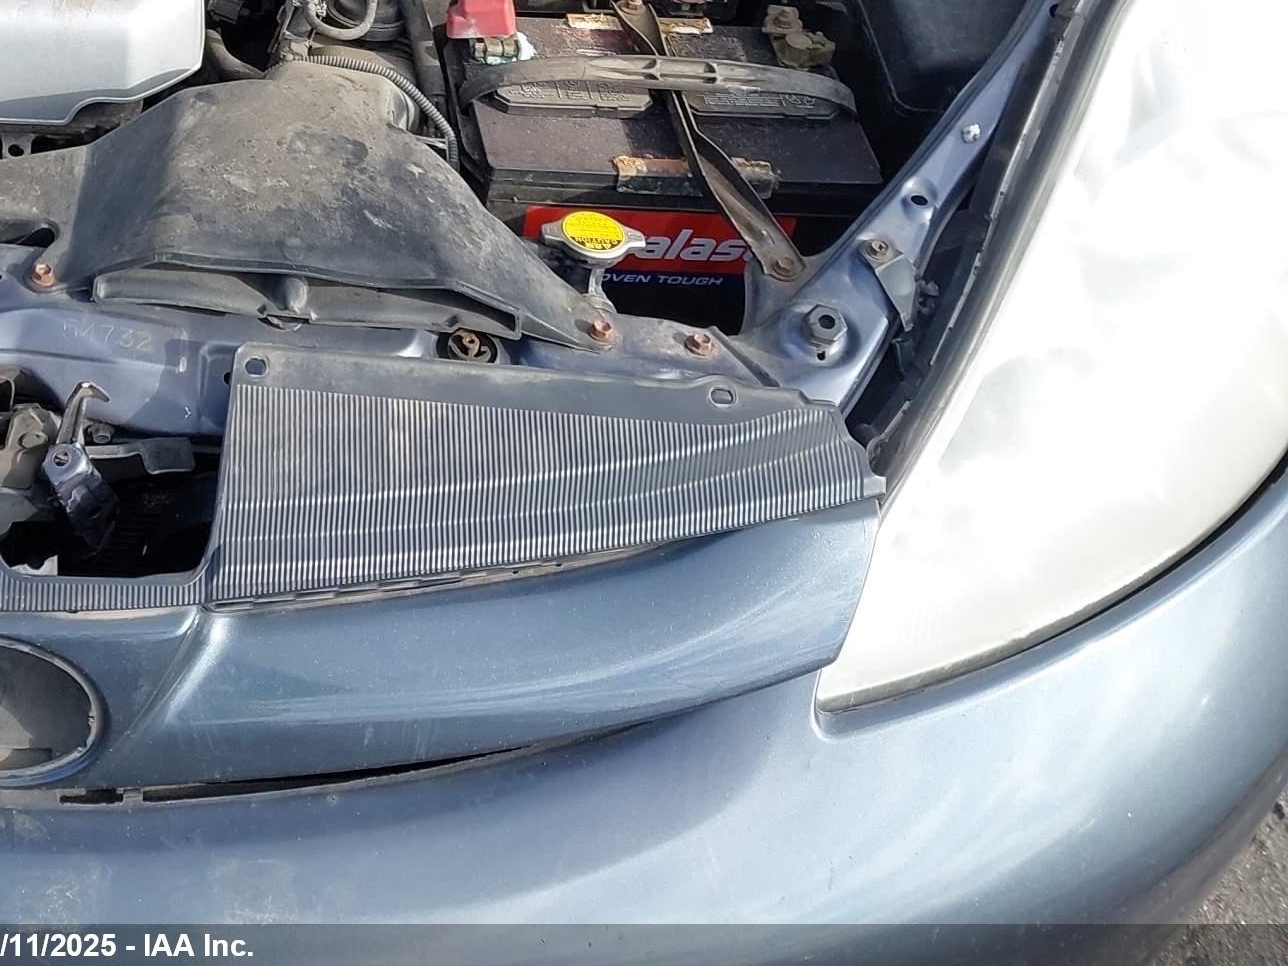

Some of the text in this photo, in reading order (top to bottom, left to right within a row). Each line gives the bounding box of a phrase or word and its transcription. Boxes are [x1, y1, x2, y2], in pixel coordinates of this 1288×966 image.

[575, 236, 619, 245] CAUTION
[633, 228, 752, 262] alas
[658, 275, 723, 286] TOUGH
